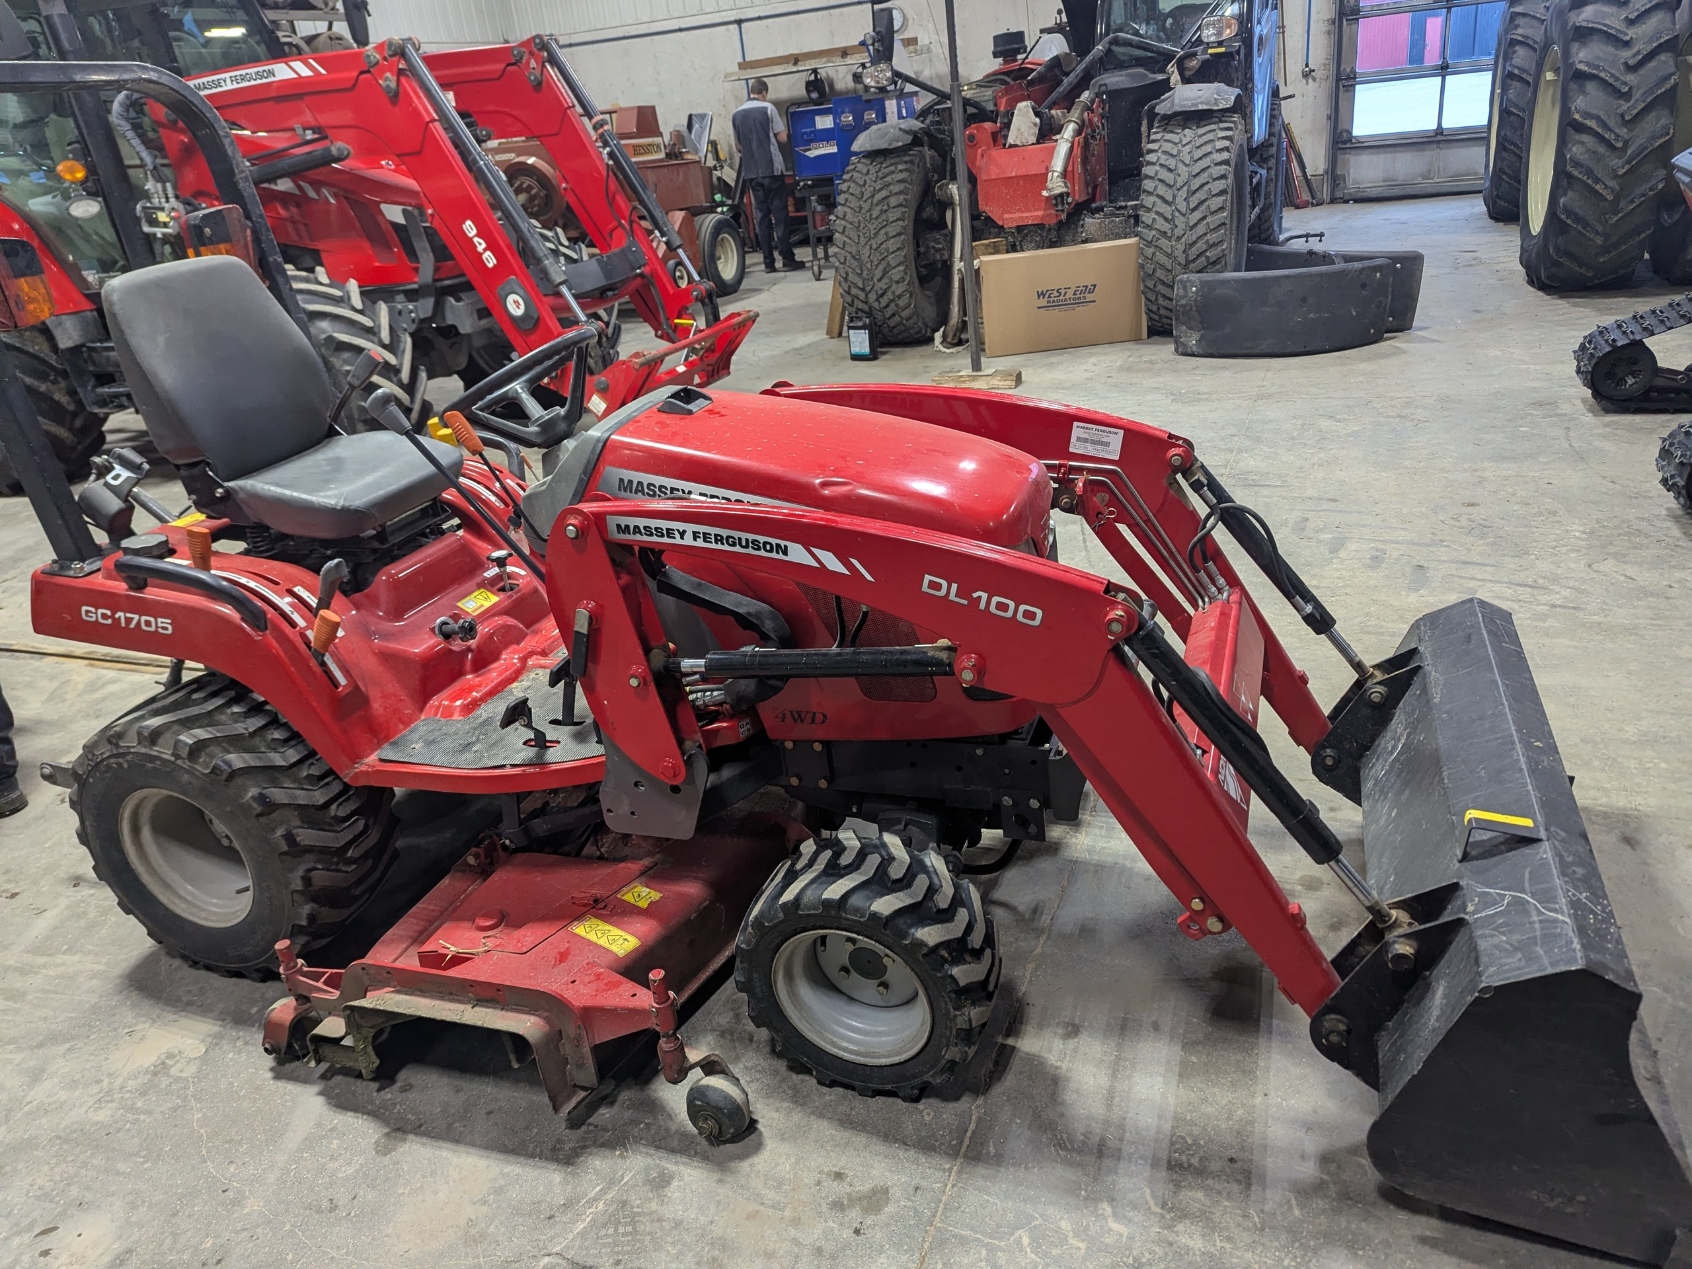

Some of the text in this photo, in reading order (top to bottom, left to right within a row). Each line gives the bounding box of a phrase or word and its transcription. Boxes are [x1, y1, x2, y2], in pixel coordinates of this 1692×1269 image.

[193, 68, 276, 92] MASSEY FERGUSON
[462, 219, 497, 269] 946
[1036, 284, 1097, 300] WEST END
[1046, 296, 1087, 304] RADIATORS
[615, 523, 789, 557] MASSEY FERGUSON
[921, 574, 1043, 627] DL100
[81, 605, 173, 635] GC1705
[774, 709, 828, 725] 4WD
